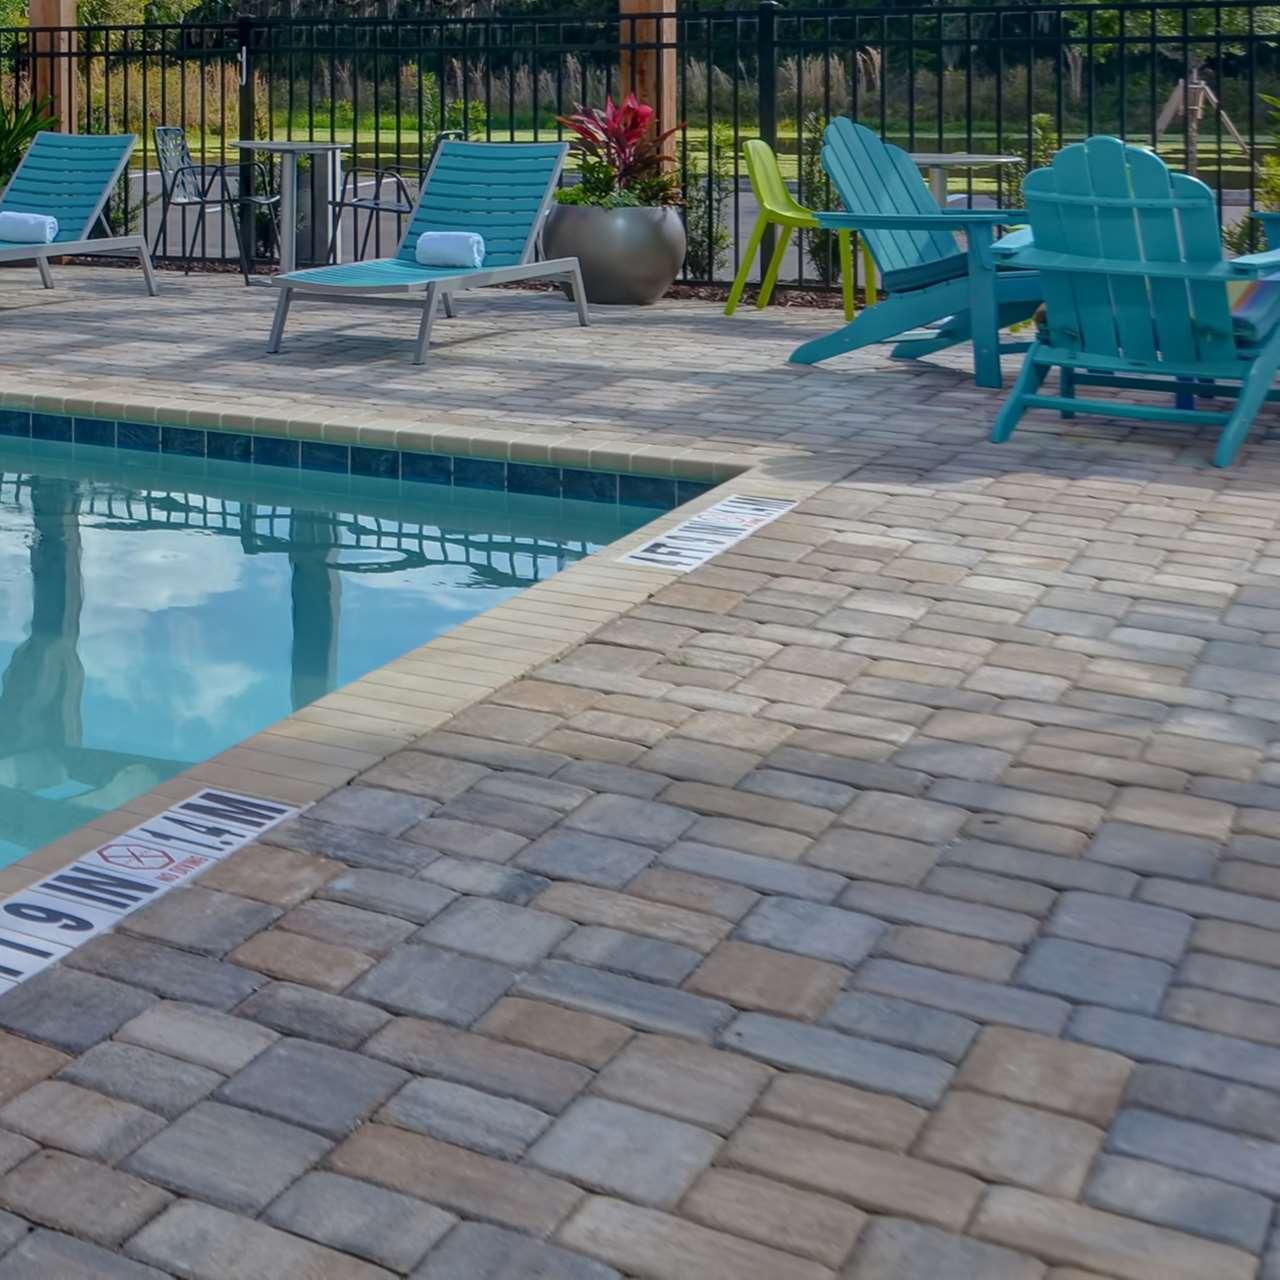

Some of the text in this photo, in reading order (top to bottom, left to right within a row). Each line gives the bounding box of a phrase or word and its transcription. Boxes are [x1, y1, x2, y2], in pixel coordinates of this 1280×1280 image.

[676, 520, 749, 538] IN
[640, 542, 715, 561] FT
[179, 791, 288, 829] M
[140, 815, 246, 852] 1.4
[38, 866, 159, 910] IN
[3, 902, 95, 932] 9
